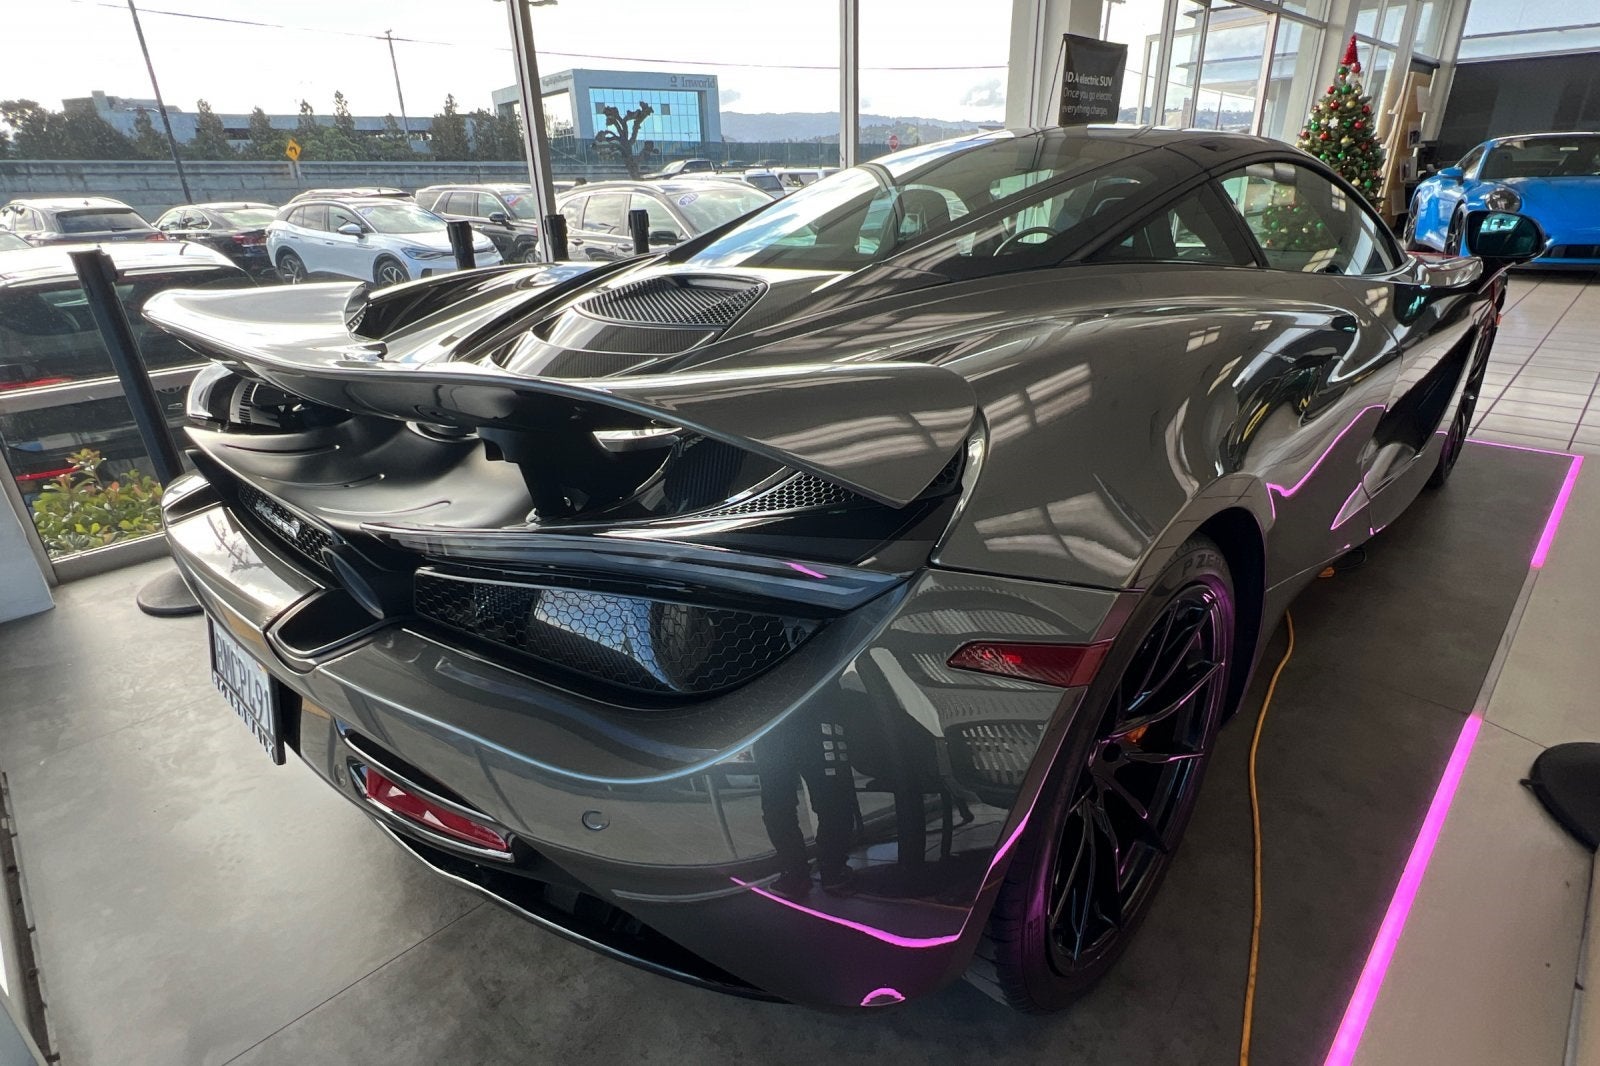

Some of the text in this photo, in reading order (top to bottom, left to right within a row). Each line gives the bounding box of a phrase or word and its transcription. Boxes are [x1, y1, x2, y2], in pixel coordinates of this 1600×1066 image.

[682, 76, 716, 89] Inworld
[1100, 75, 1113, 87] SUV
[1063, 86, 1080, 99] Once
